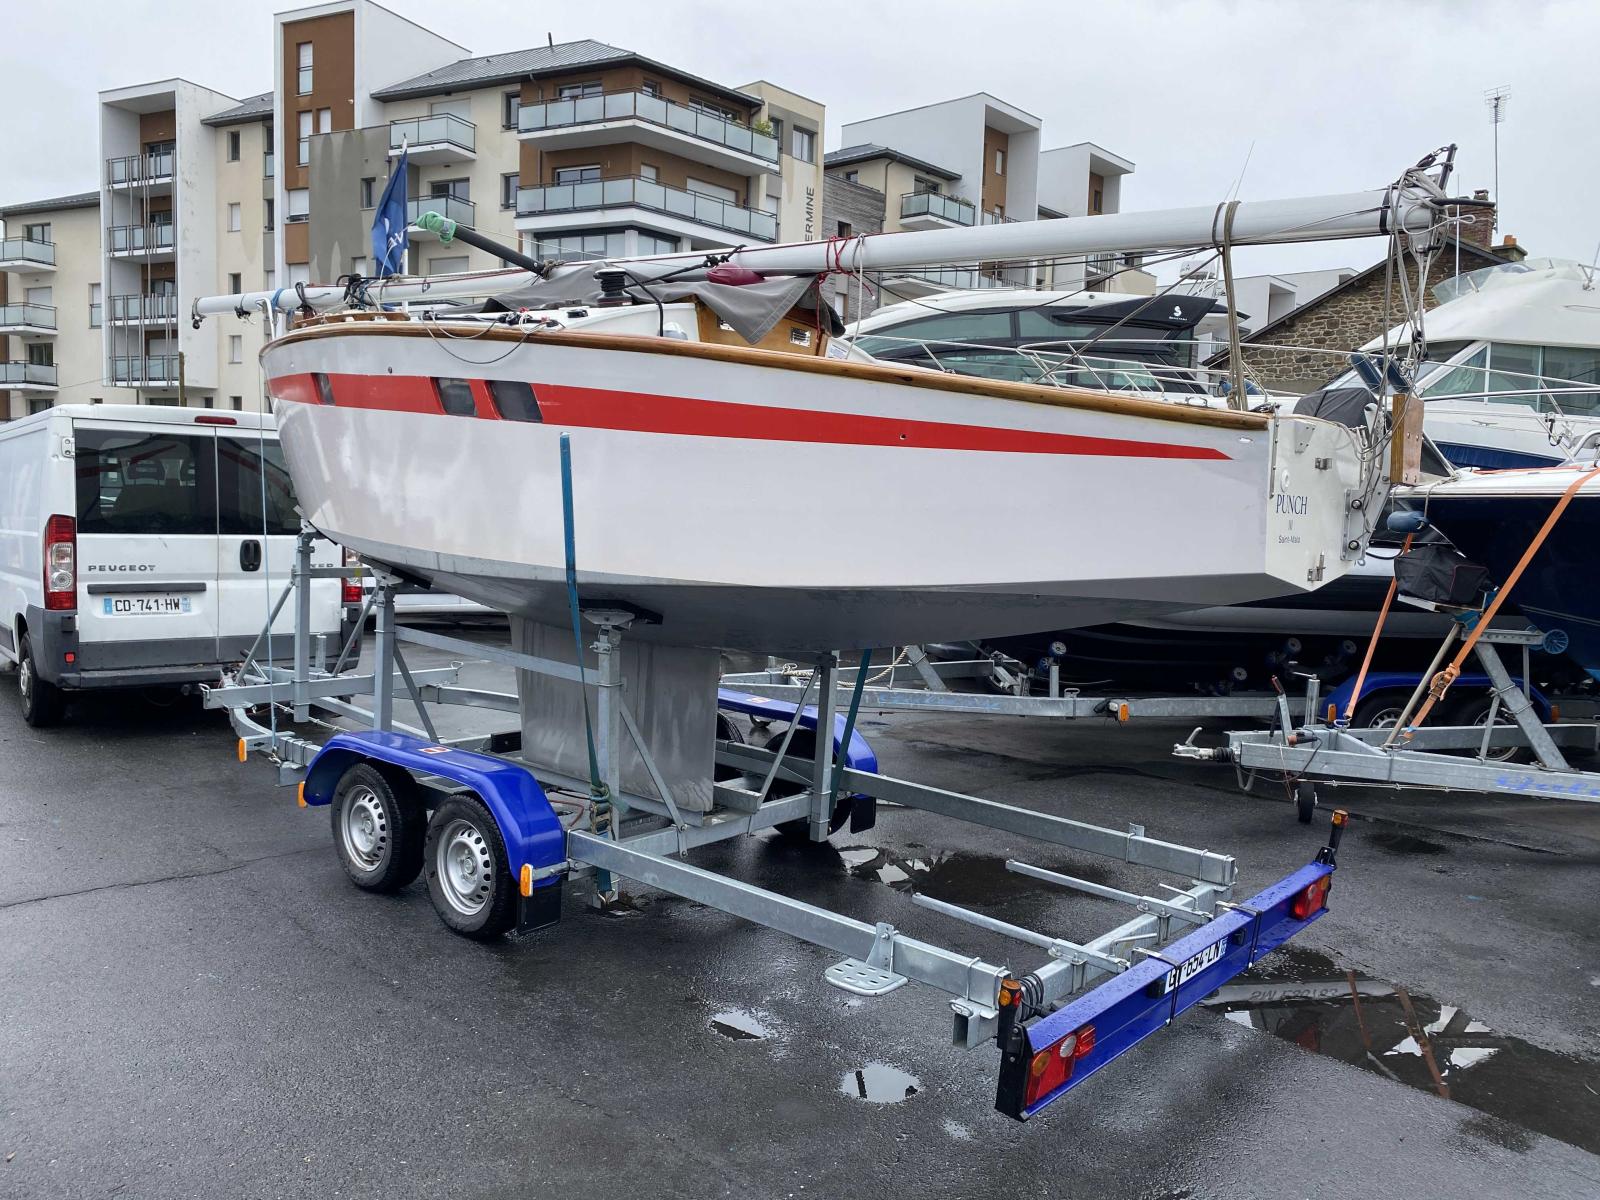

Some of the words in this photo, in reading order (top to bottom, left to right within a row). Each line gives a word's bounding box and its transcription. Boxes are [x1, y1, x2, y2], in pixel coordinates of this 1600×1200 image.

[1276, 494, 1308, 515] PUNCH
[88, 564, 157, 572] PEUGEOT
[115, 598, 180, 612] CD-741-HW
